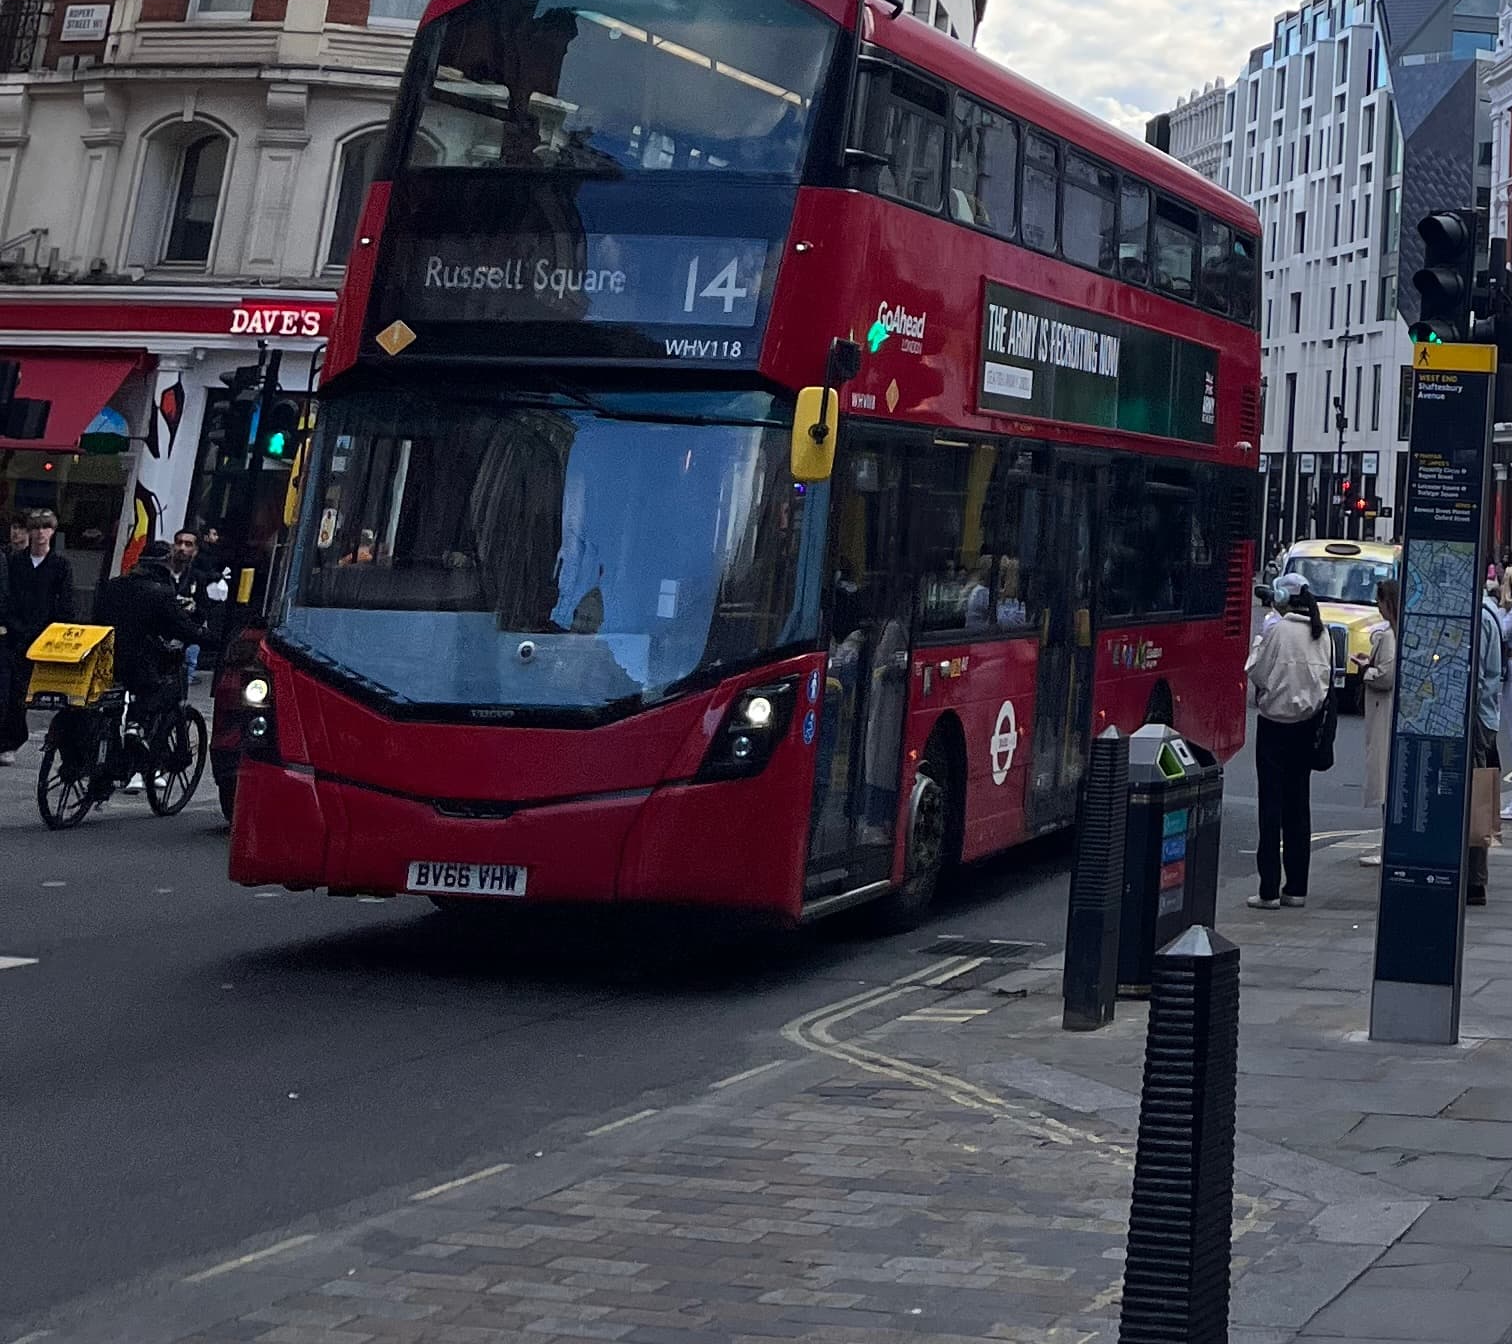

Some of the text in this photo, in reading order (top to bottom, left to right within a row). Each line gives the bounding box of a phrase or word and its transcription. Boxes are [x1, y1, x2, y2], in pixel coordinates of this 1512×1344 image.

[424, 256, 627, 298] Russell Square
[683, 255, 748, 313] 14
[230, 309, 320, 336] DAVE'S
[878, 301, 926, 339] GoAhead
[665, 339, 742, 357] WHV118
[988, 304, 1121, 378] THE ARMY IS RECRUITING NOW
[415, 863, 519, 891] BV66 VHW
